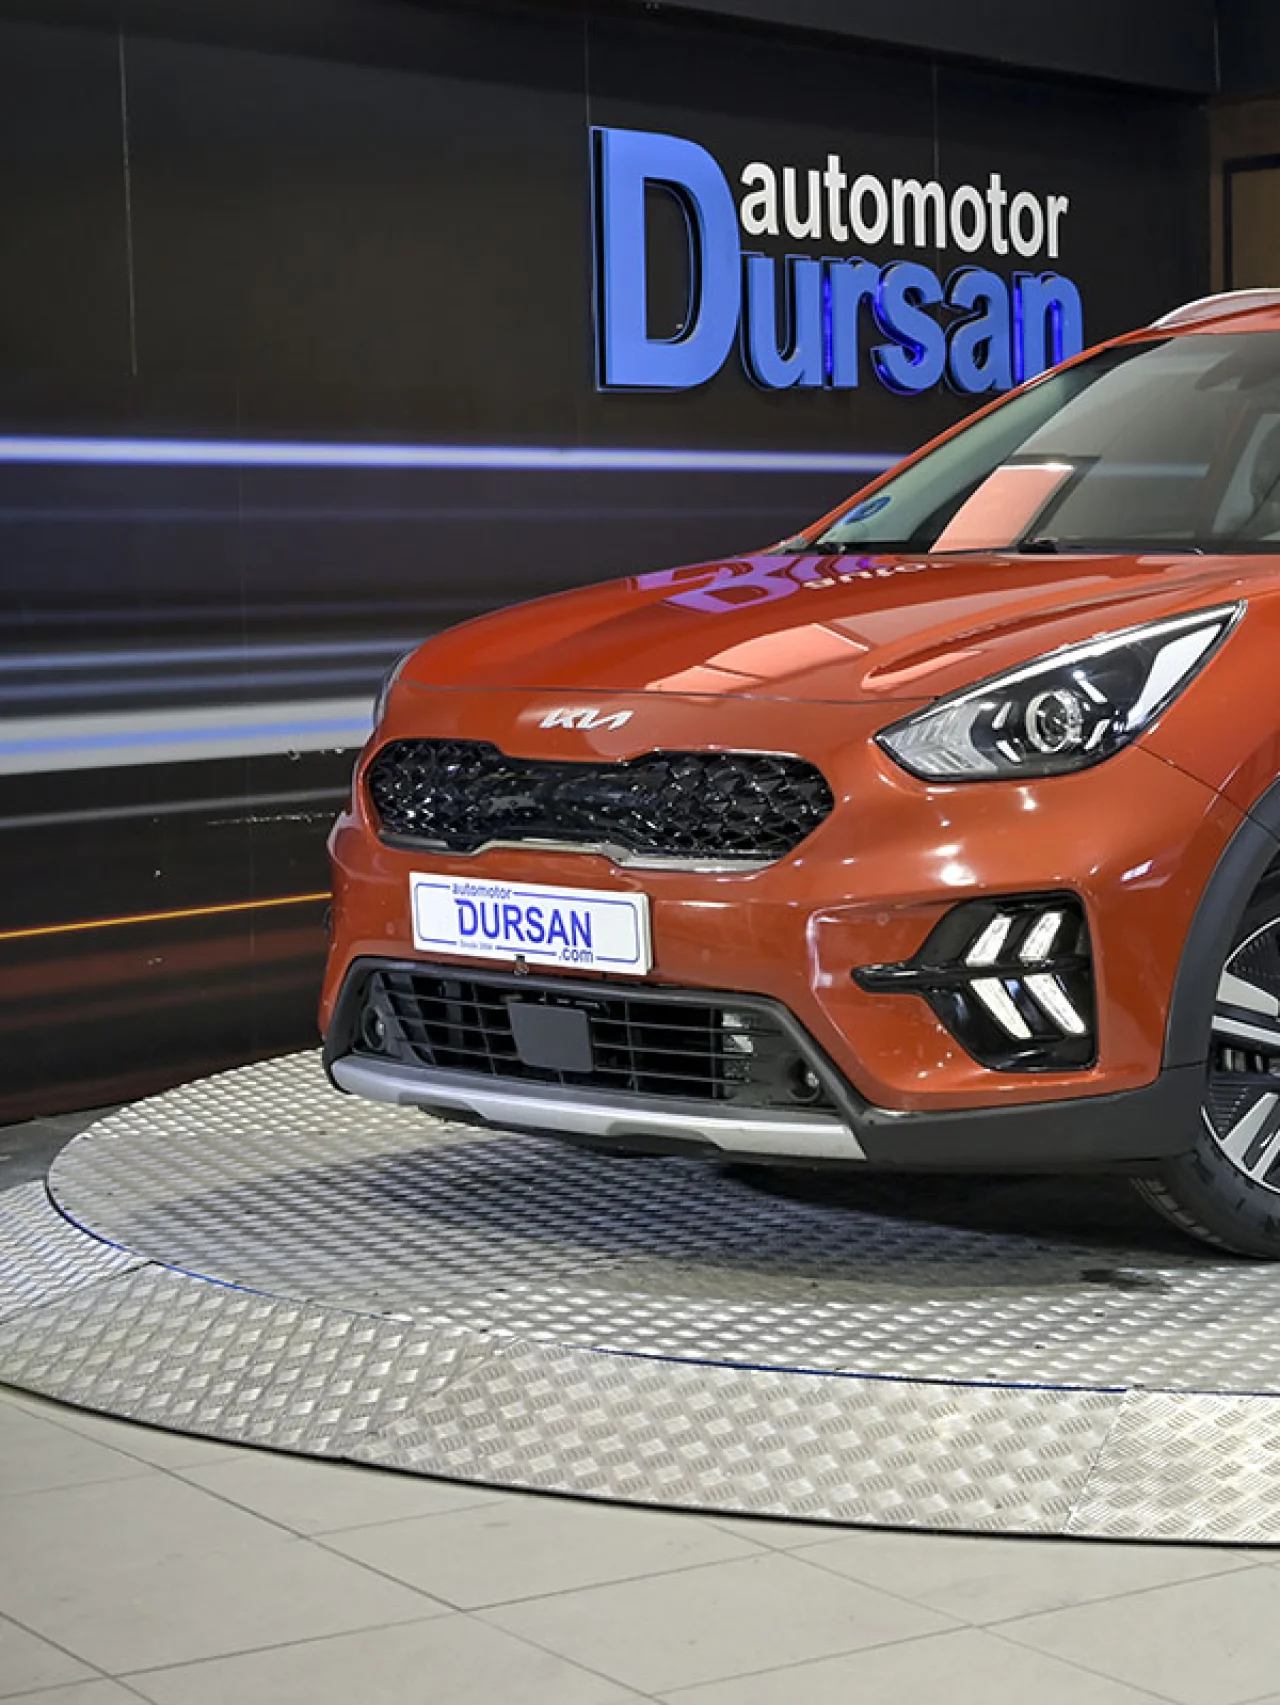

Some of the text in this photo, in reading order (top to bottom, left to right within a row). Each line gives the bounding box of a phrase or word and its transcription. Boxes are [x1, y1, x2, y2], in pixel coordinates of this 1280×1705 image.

[740, 154, 1069, 258] automotor
[590, 126, 1084, 394] Dursan
[539, 707, 634, 731] KIA
[451, 882, 513, 899] automotor
[454, 898, 593, 949] DURSAN
[558, 947, 594, 964] .com
